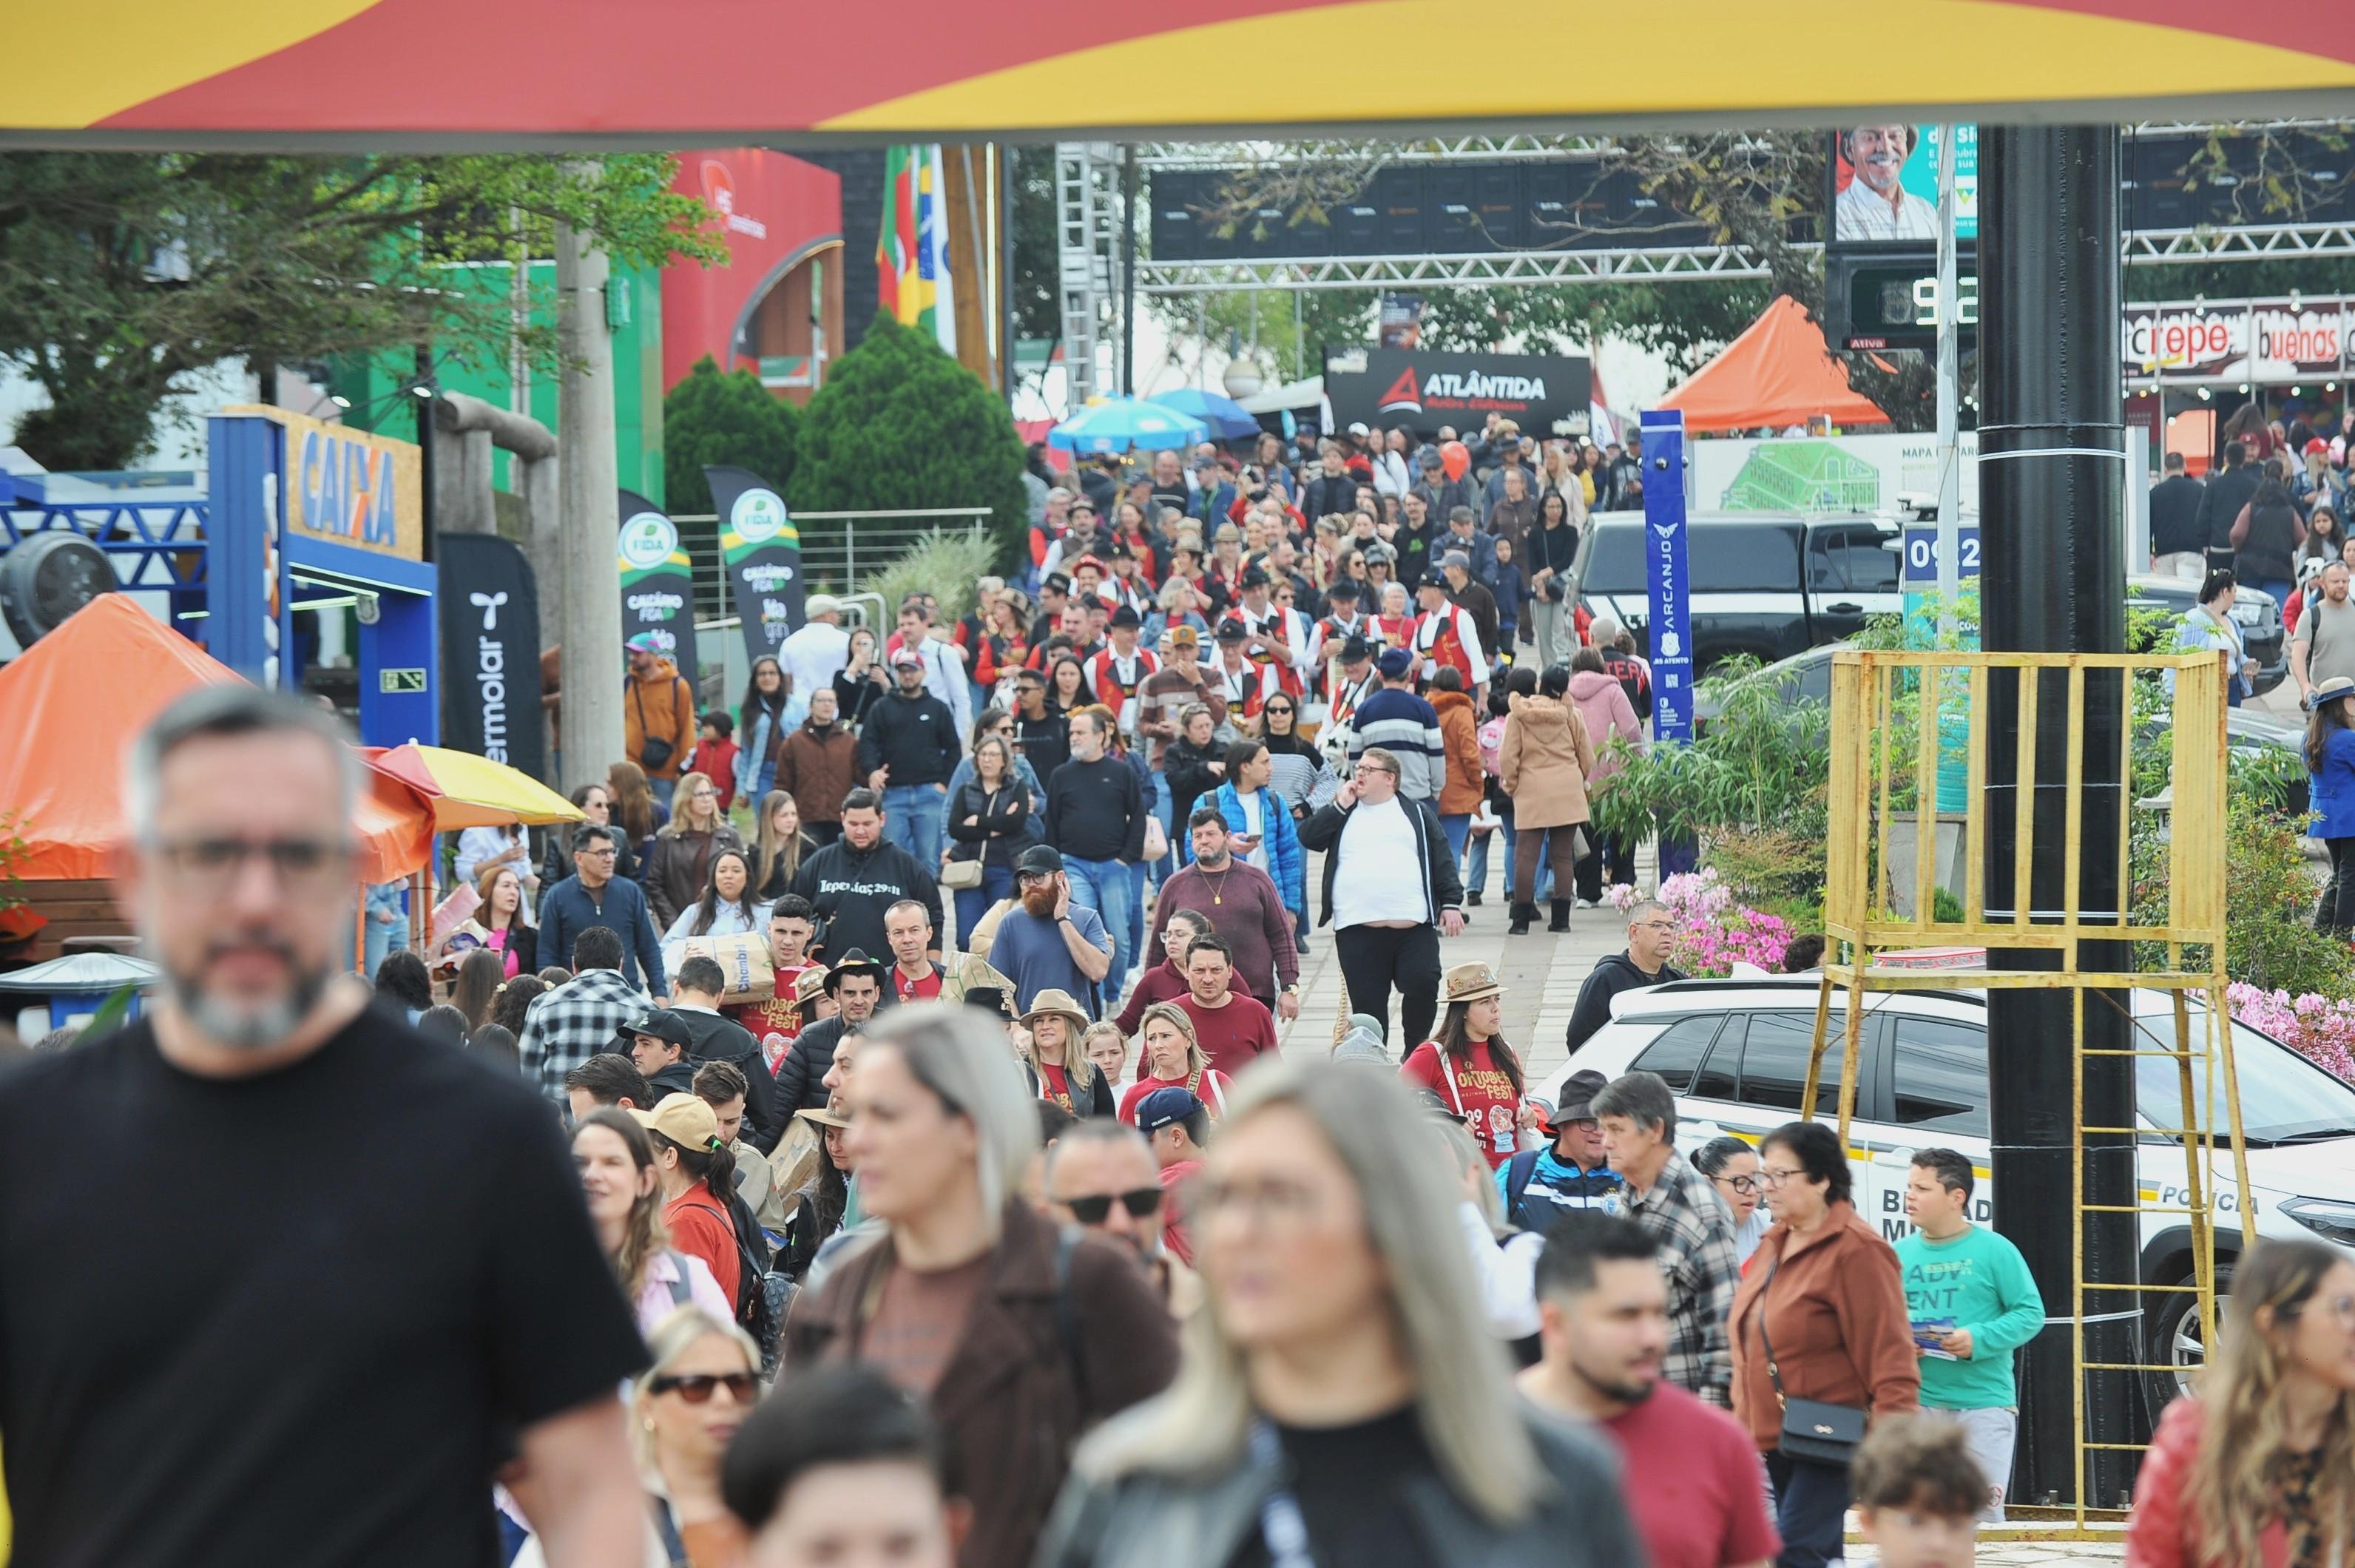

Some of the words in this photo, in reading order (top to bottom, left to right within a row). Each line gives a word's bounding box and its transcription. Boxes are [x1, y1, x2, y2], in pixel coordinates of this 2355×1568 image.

[1851, 339, 1884, 348] Ativa
[2132, 323, 2229, 363] crepe
[2260, 319, 2337, 359] buenas
[1423, 370, 1546, 400] ATLÂNTIDA
[1902, 448, 1932, 458] MAPA
[302, 431, 396, 547] CAIXA
[1661, 541, 1675, 629] ARCANJO
[734, 944, 750, 993] Chambril
